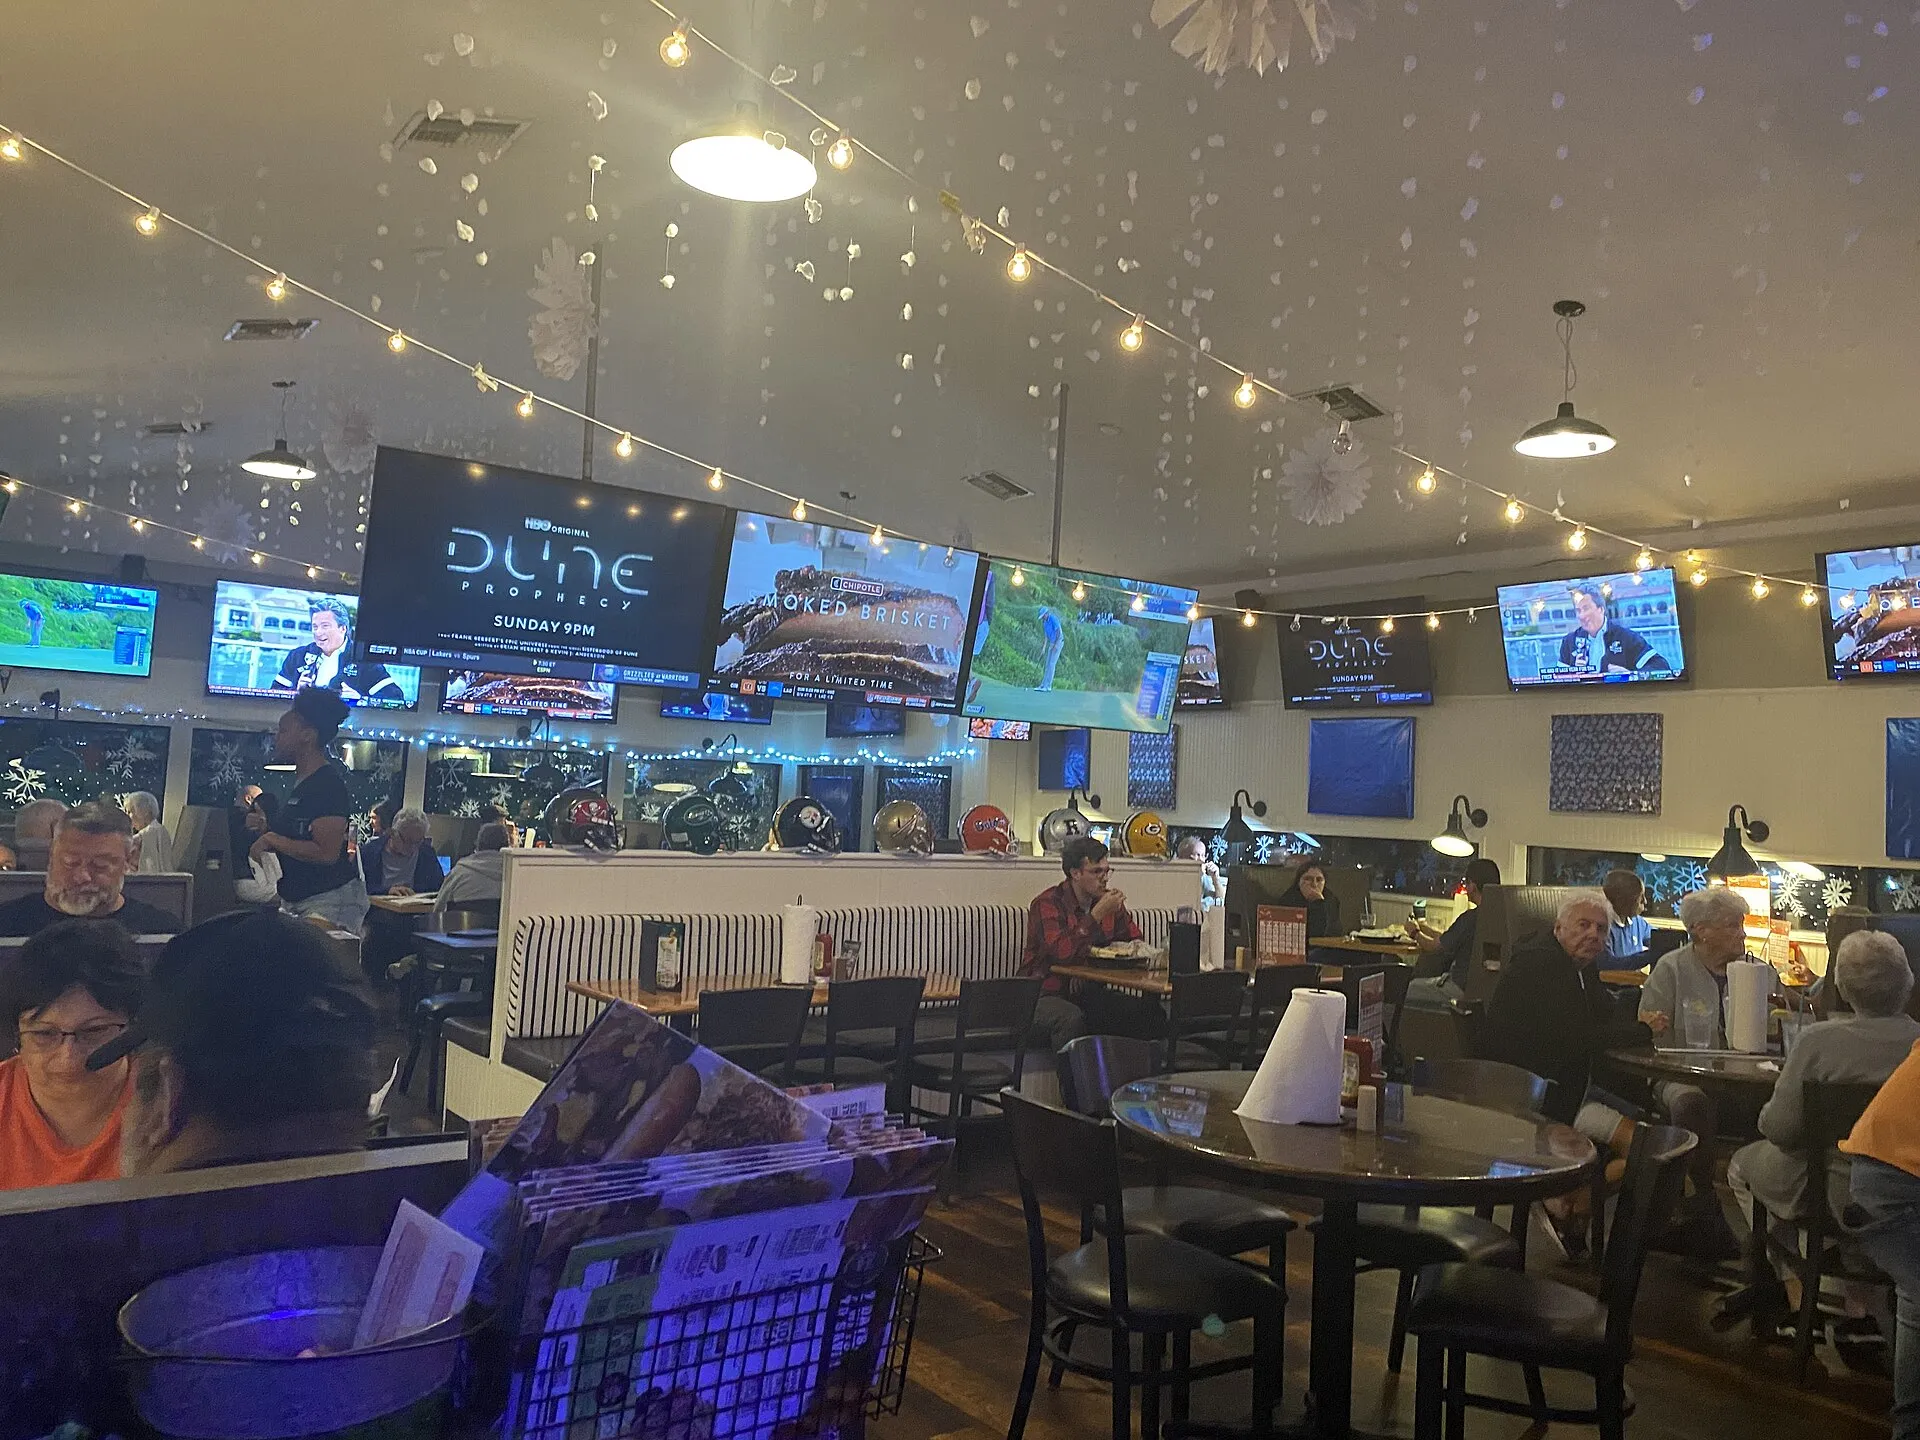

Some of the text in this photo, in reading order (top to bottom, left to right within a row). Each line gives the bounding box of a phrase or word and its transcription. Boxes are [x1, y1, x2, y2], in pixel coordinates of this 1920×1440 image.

[524, 517, 590, 538] HBO ORIGINAL
[447, 527, 653, 596] DUNE
[462, 580, 631, 610] PROPHECY
[842, 581, 882, 595] CHIPOTLE
[493, 614, 596, 638] SUNDAY 9PM
[860, 605, 951, 631] BRISKET
[369, 645, 397, 655] ESPN
[1309, 635, 1393, 660] DUNE
[432, 650, 452, 658] Lakers
[463, 653, 480, 662] Spurs
[1184, 654, 1207, 665] SKET
[623, 669, 655, 679] GRIZZLIES
[661, 673, 689, 682] WARRIORS
[790, 672, 893, 690] FOR A LIMITED TIME
[1332, 674, 1359, 683] SUNDAY
[1145, 824, 1161, 836] G
